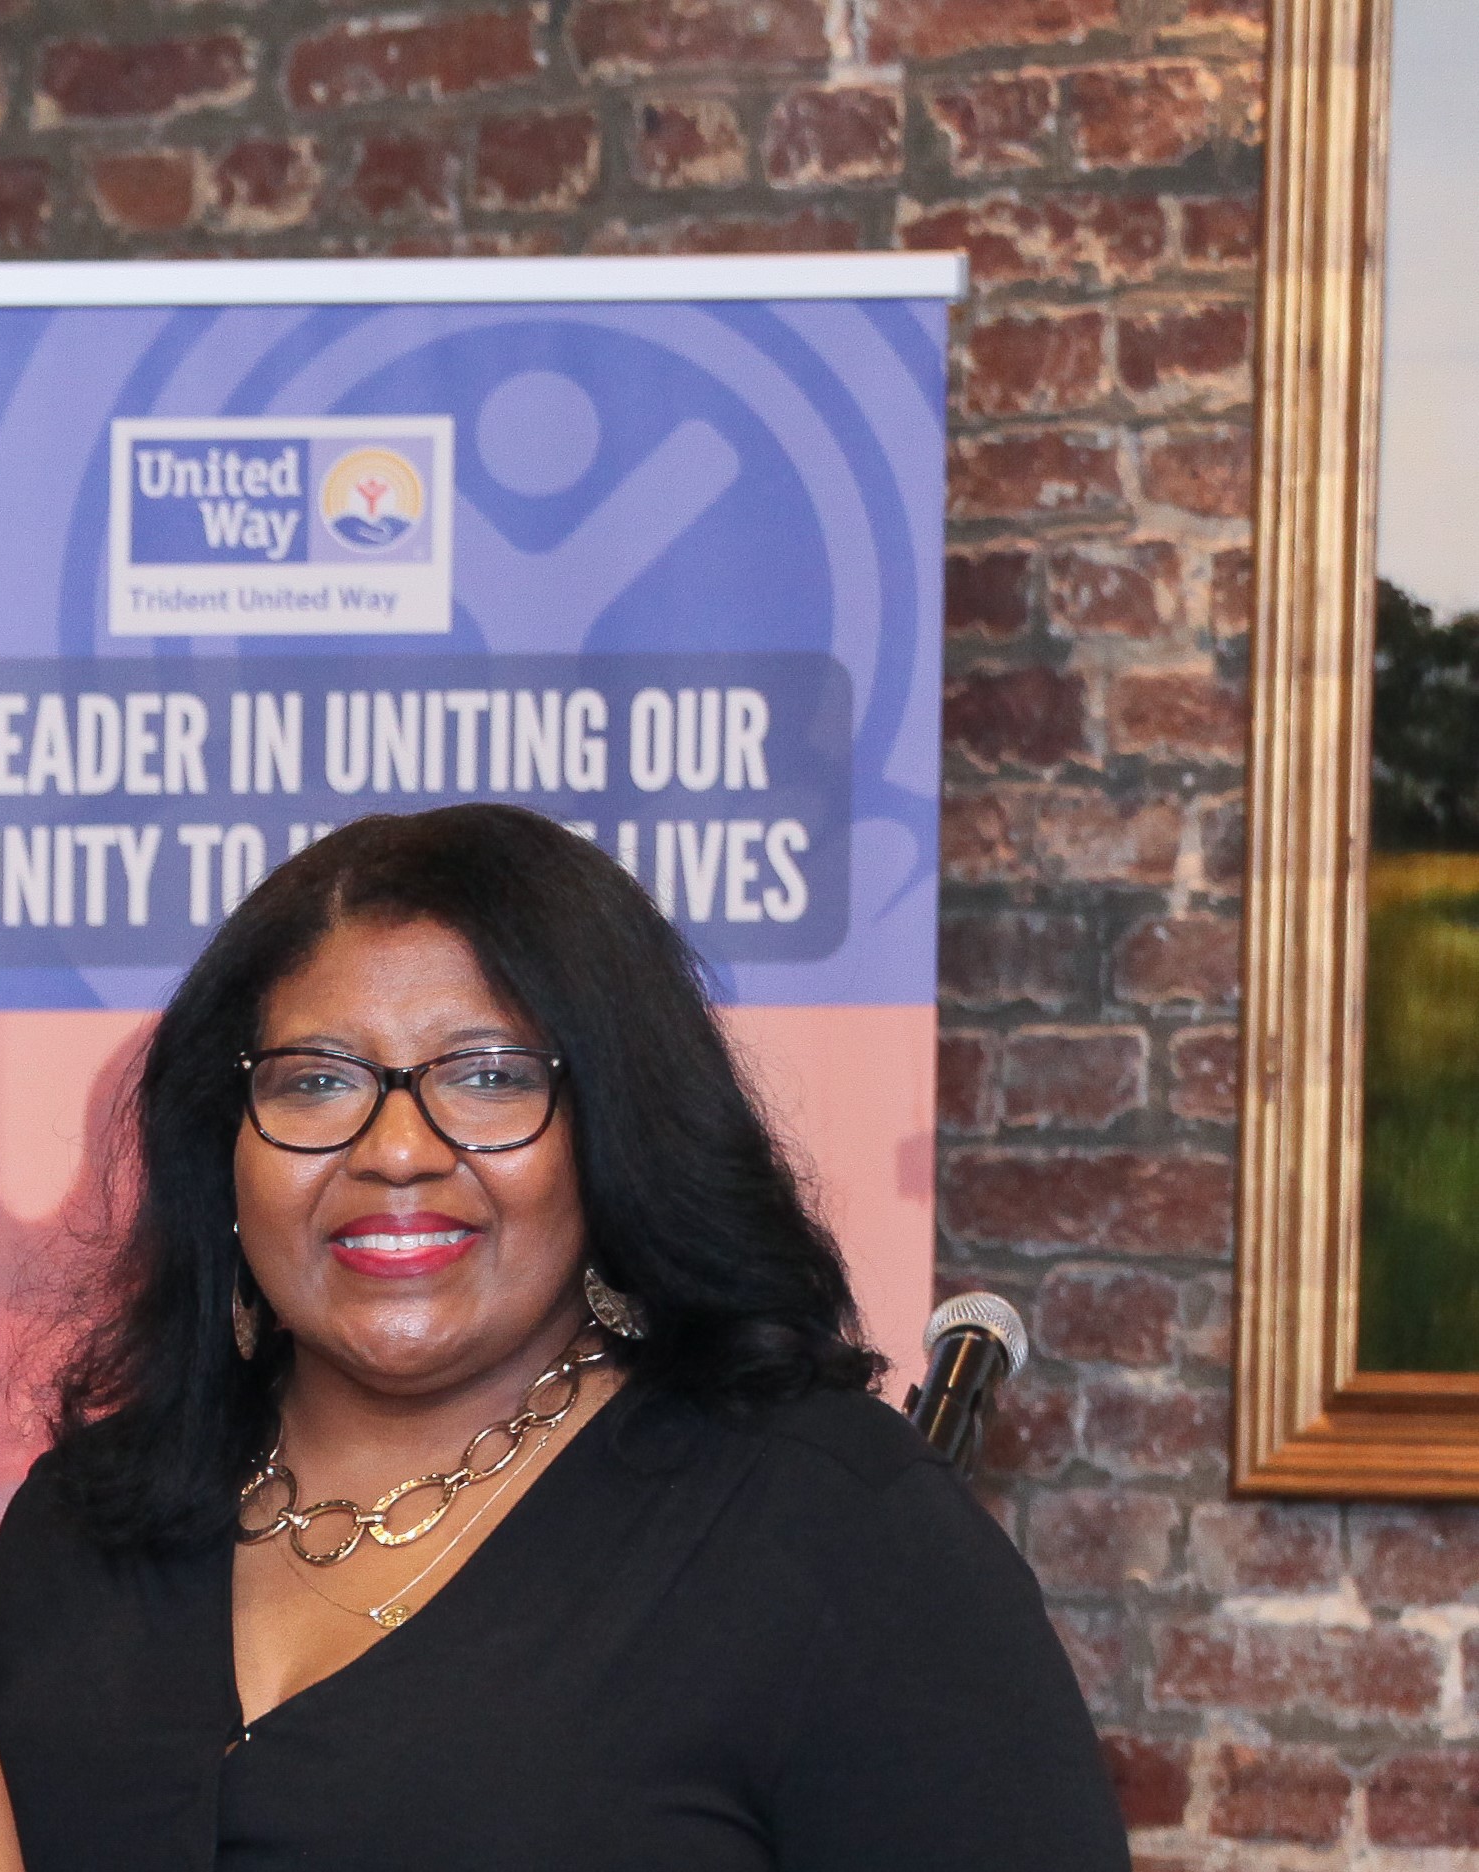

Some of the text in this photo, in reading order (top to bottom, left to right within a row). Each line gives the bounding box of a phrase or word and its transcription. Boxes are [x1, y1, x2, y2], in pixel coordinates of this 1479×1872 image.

[137, 447, 302, 498] United
[200, 501, 301, 561] Way
[130, 585, 399, 614] Trident United Way
[230, 691, 303, 795] IN
[325, 687, 609, 794] UNITING
[629, 686, 769, 792] OUR
[176, 822, 266, 926] TO
